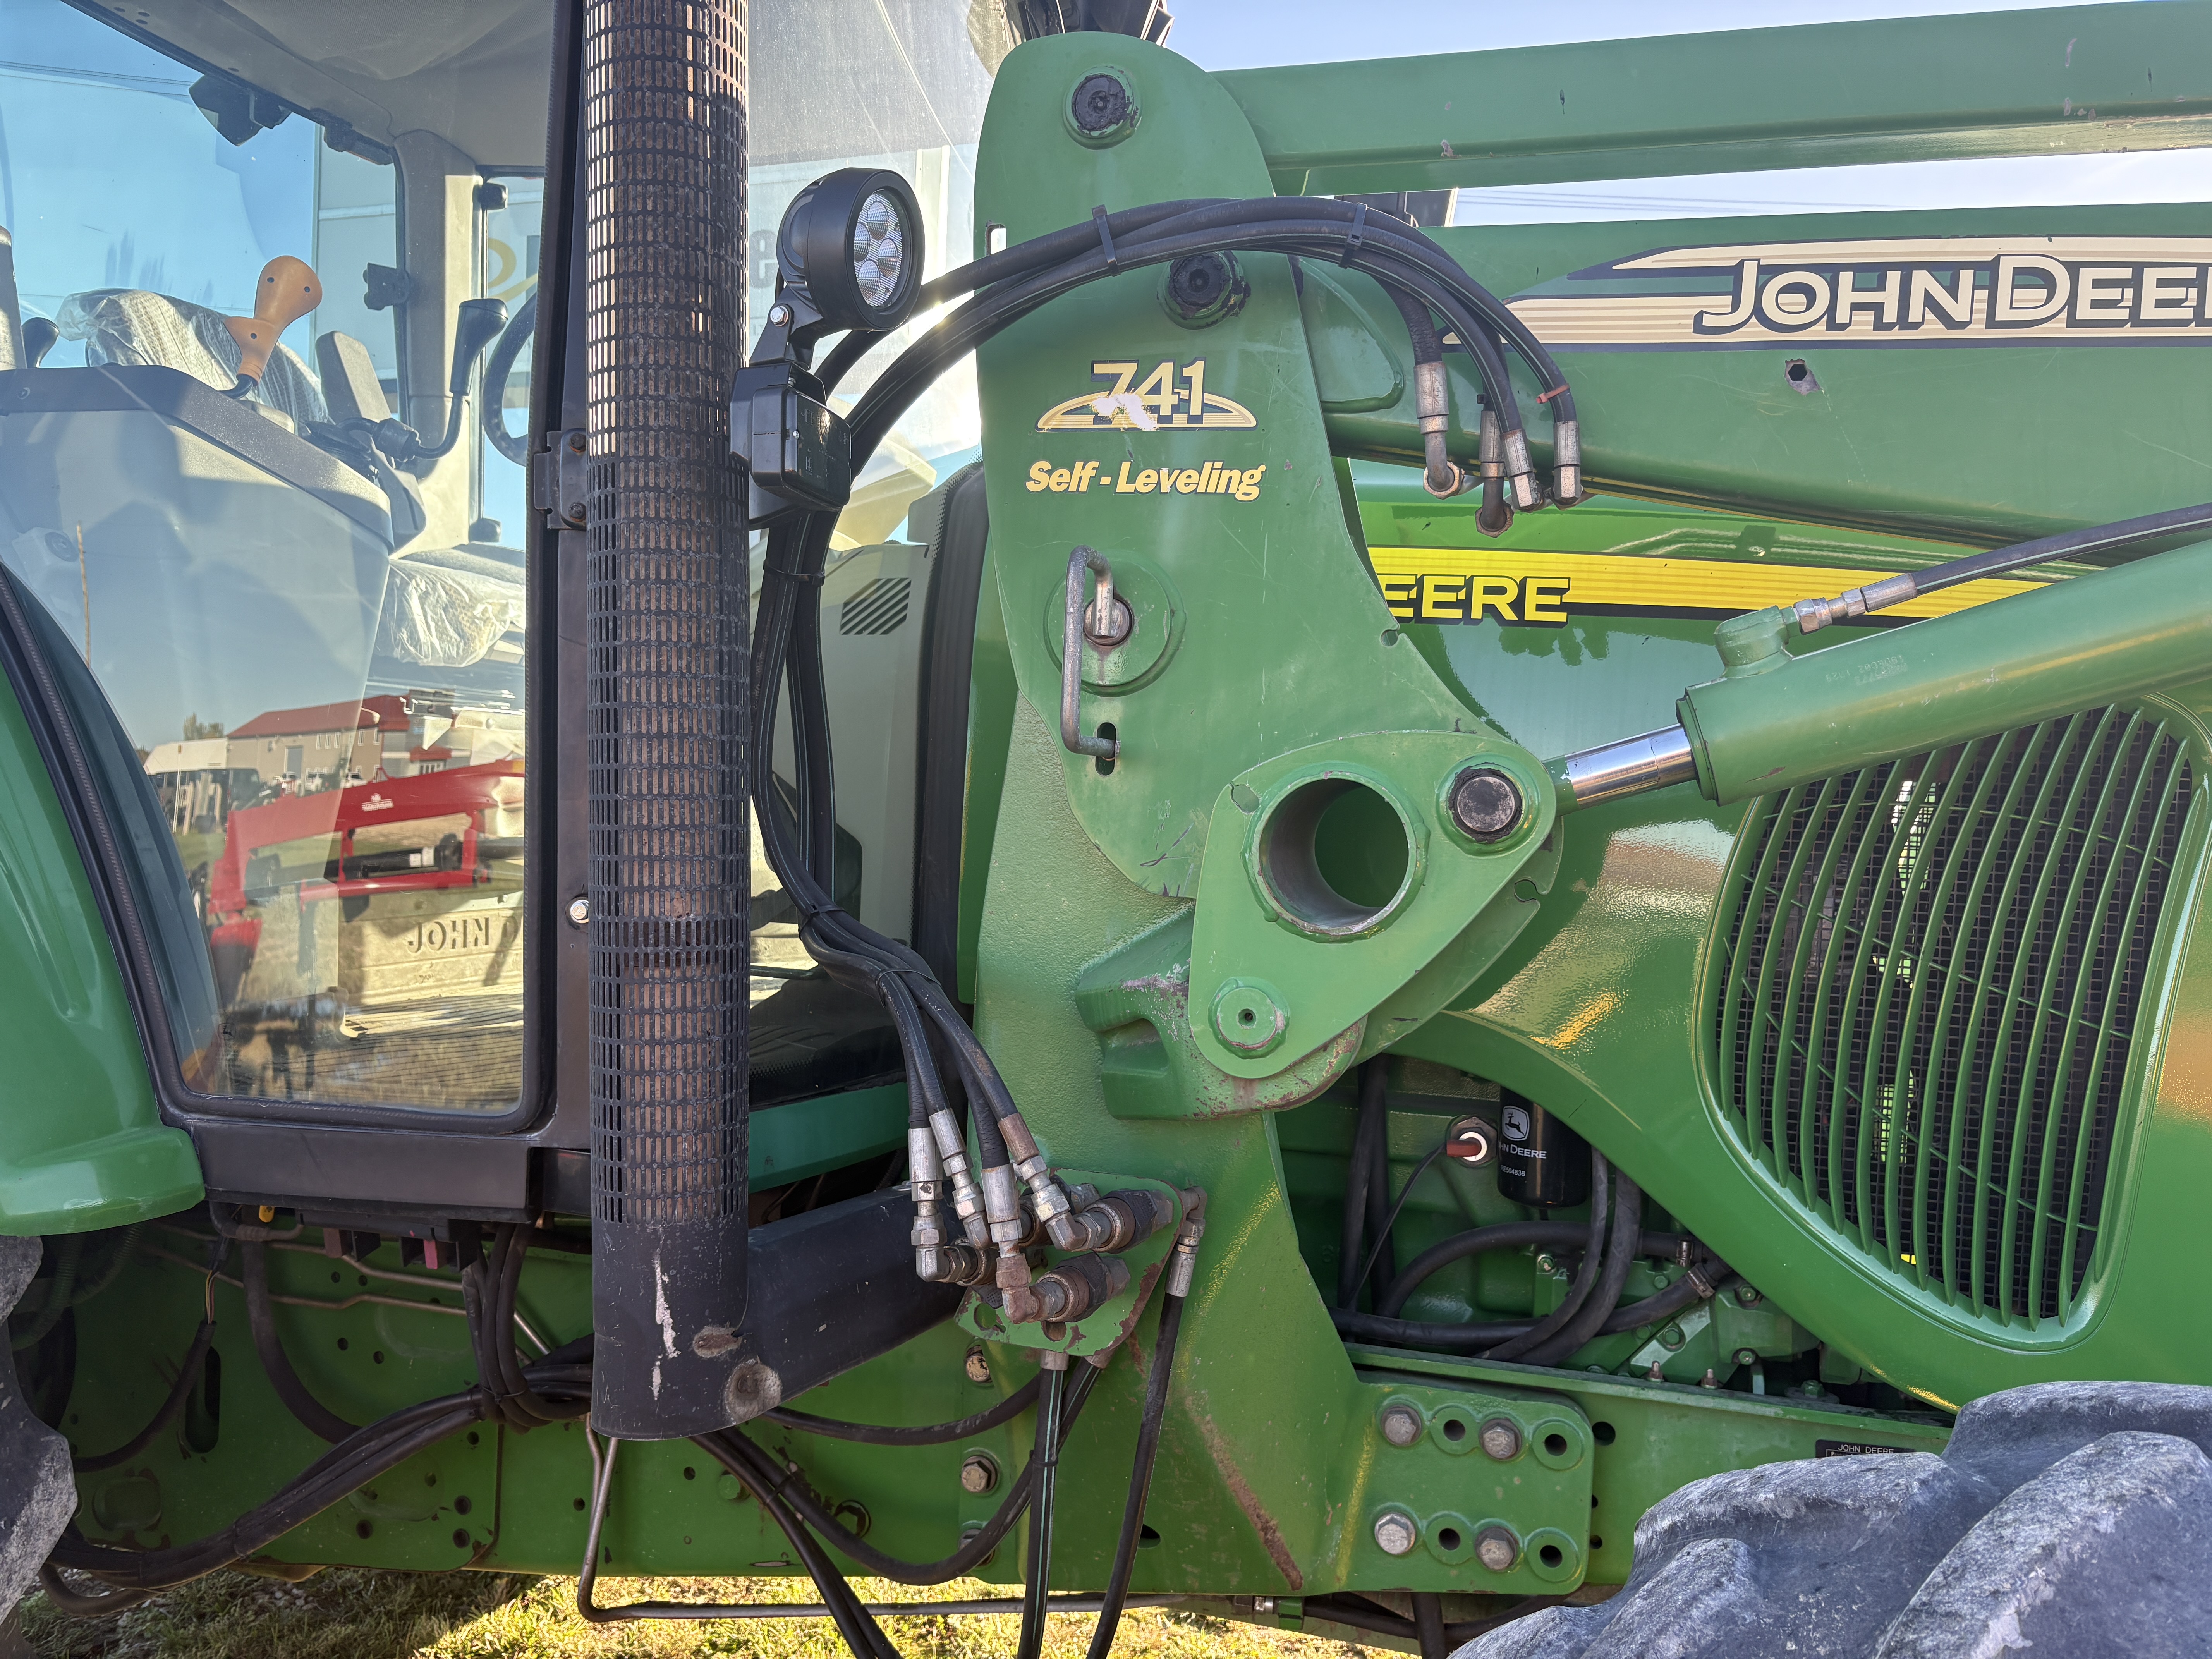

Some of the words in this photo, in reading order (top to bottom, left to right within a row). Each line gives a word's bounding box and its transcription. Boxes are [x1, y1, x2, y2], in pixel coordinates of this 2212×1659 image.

[1701, 260, 1975, 327] JOHN
[1994, 254, 2212, 322] DEE
[1091, 359, 1206, 416] 741
[1025, 460, 1100, 493] Self
[1115, 460, 1267, 501] Leveling
[1376, 575, 1570, 623] EERE
[407, 916, 490, 953] JOHN
[1498, 1141, 1509, 1152] HN
[1510, 1144, 1547, 1159] DEERE
[1838, 1444, 1860, 1453] JOHN
